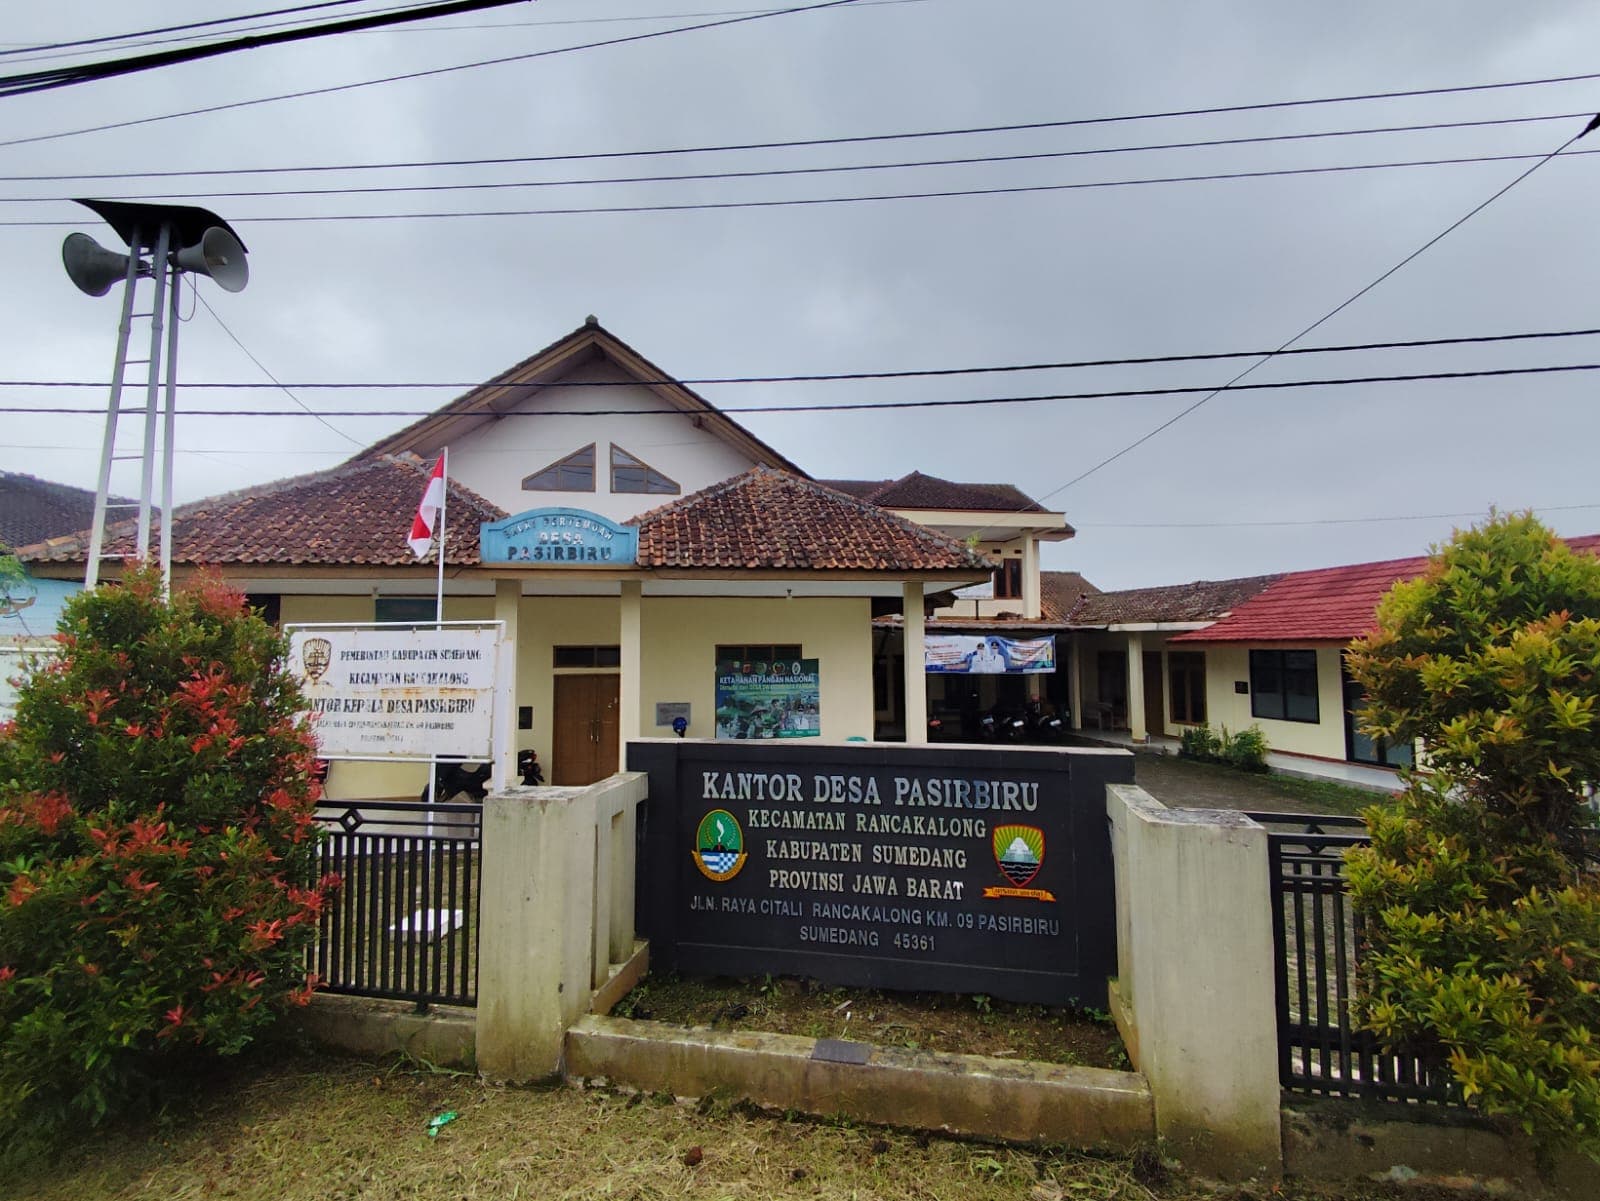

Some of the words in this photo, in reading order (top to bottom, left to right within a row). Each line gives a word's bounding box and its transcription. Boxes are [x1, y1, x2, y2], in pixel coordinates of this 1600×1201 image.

[539, 531, 583, 544] DESA
[702, 772, 804, 801] KANTOR
[813, 775, 881, 805] DESA
[894, 777, 1039, 812] PASIRBIRU
[748, 809, 846, 831] KECAMATAN
[856, 813, 986, 838] RANCAKALONG
[766, 840, 862, 863] KABUPATEN
[872, 845, 967, 869] SUMEDANG
[769, 869, 844, 892] PROVINSI
[852, 875, 898, 896] JAWA
[907, 878, 964, 900] BARAT
[690, 896, 718, 911] JLN.
[722, 897, 756, 914] RAYA
[760, 899, 802, 917] CITALI
[812, 902, 922, 925] RANCAKALONG
[926, 910, 953, 927] KM.
[957, 913, 974, 929] 09
[978, 914, 1060, 936] PASIRBIRU
[800, 926, 879, 947] SUMEDANG
[894, 933, 936, 951] 45361
